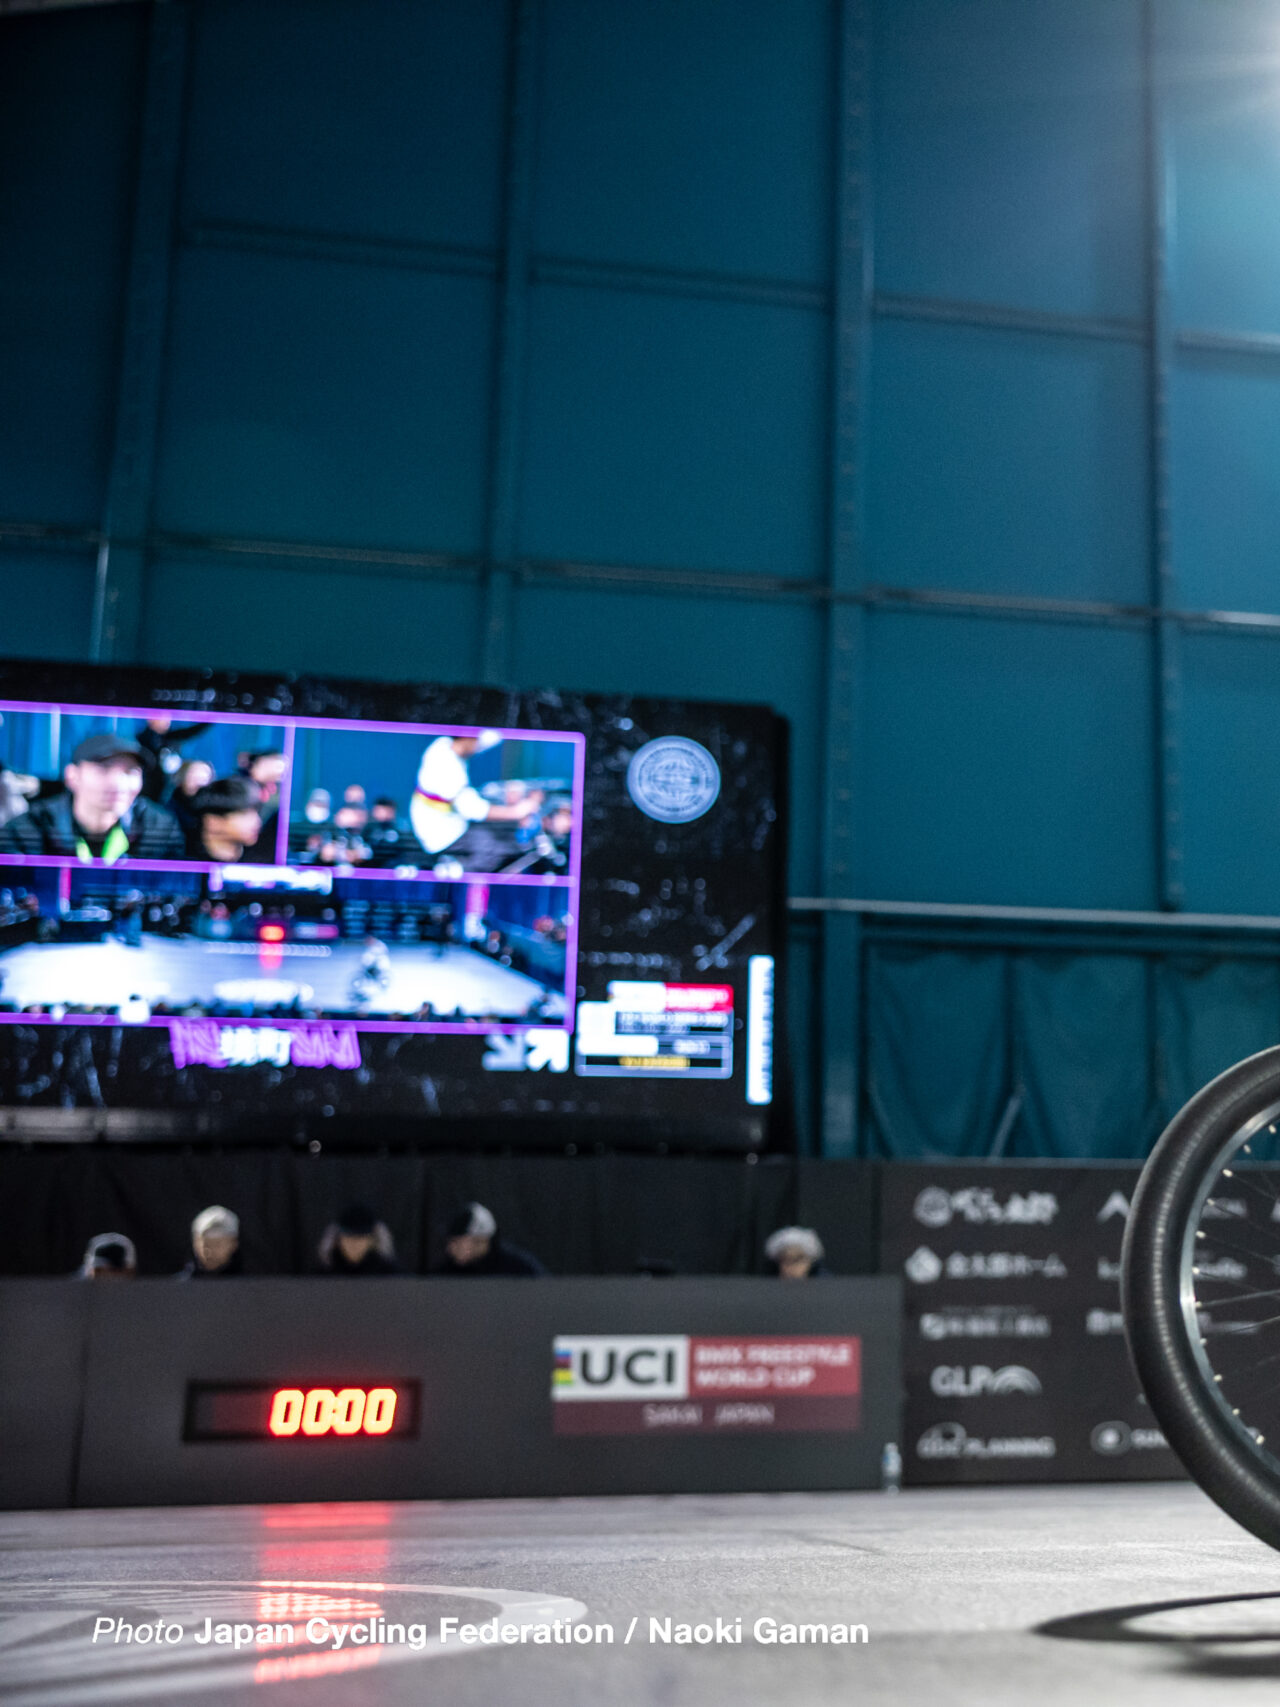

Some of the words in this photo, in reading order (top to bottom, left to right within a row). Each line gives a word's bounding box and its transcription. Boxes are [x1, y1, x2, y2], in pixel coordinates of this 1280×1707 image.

[579, 1347, 675, 1386] UCI
[694, 1344, 743, 1365] BMX
[746, 1343, 851, 1367] FREESTYLE
[694, 1366, 769, 1388] WORLD
[771, 1365, 816, 1388] CUP
[268, 1388, 397, 1437] 00:00
[714, 1402, 776, 1426] JAPAN
